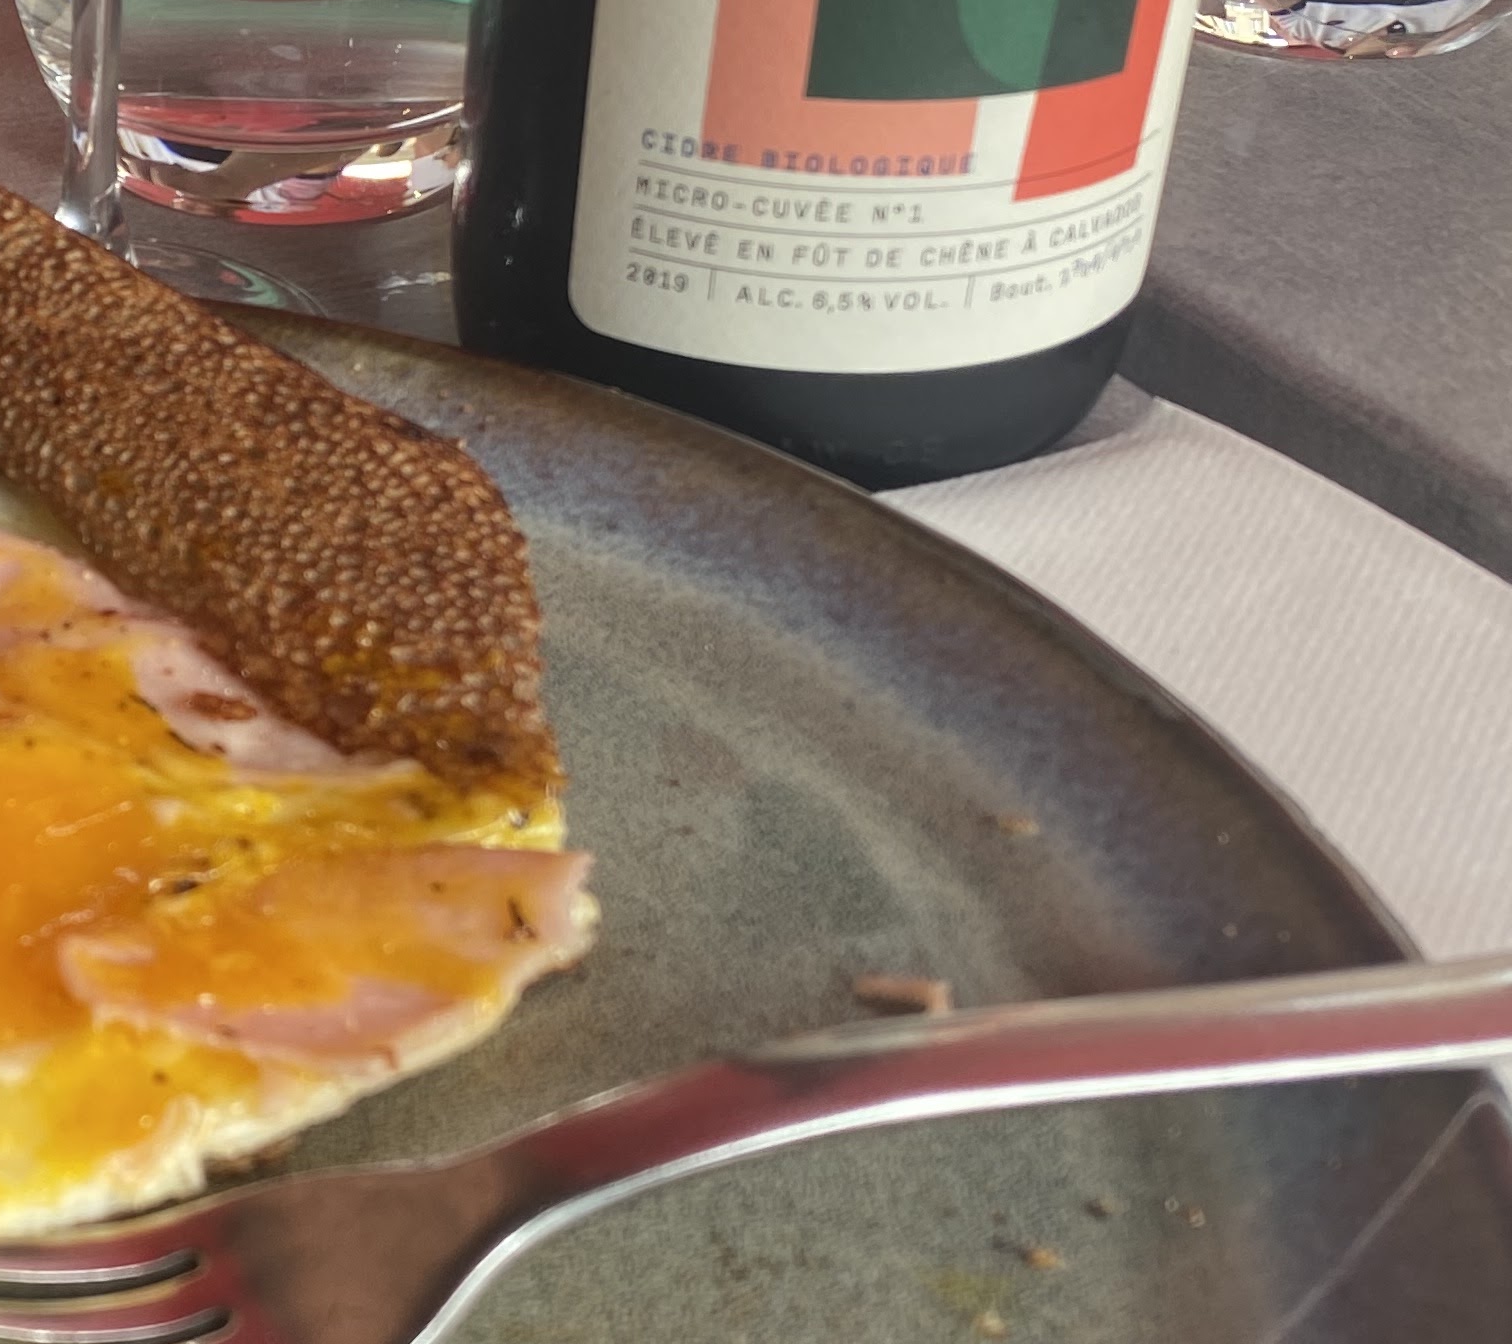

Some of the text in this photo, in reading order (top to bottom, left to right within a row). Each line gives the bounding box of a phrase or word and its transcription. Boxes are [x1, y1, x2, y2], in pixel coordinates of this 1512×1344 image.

[640, 127, 975, 178] CIDRE BIOLOGIQUE
[636, 175, 924, 225] MICRO-CUVÉE N°1
[630, 215, 720, 256] ÉLEVÉ
[736, 238, 774, 262] EN
[791, 241, 851, 268] FÛT
[864, 246, 904, 269] DE
[920, 238, 1011, 268] CHÊNE
[625, 261, 689, 294] 2019
